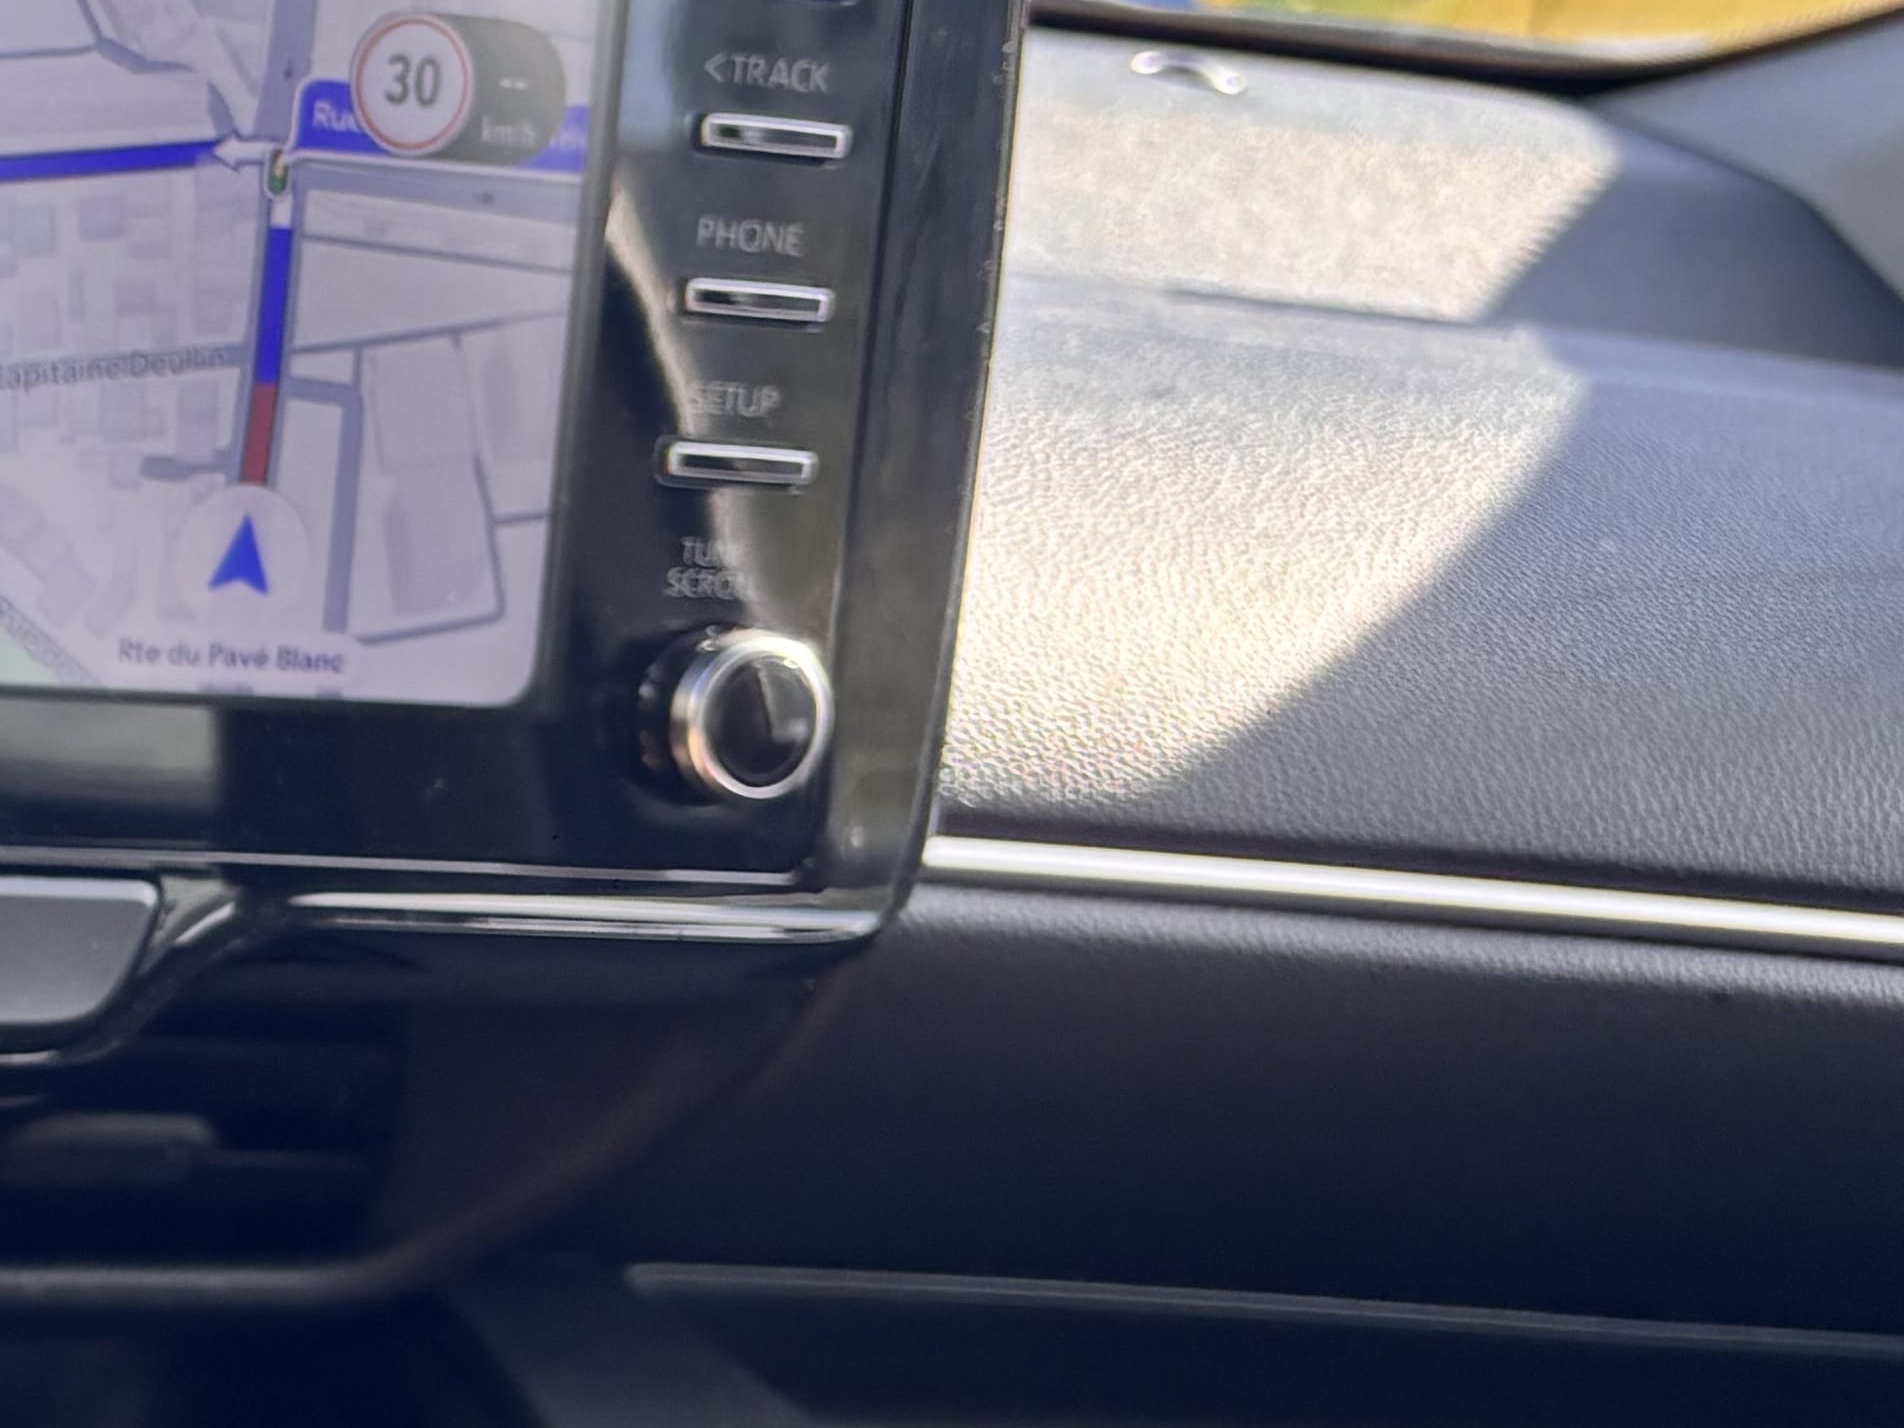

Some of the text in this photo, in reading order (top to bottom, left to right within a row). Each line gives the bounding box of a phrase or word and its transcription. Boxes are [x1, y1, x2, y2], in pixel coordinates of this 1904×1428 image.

[383, 53, 442, 108] 30
[696, 214, 808, 257] PHONE
[689, 381, 781, 419] SETUP
[118, 638, 161, 665] Rte
[167, 641, 200, 667] du
[276, 645, 345, 673] Blanc
